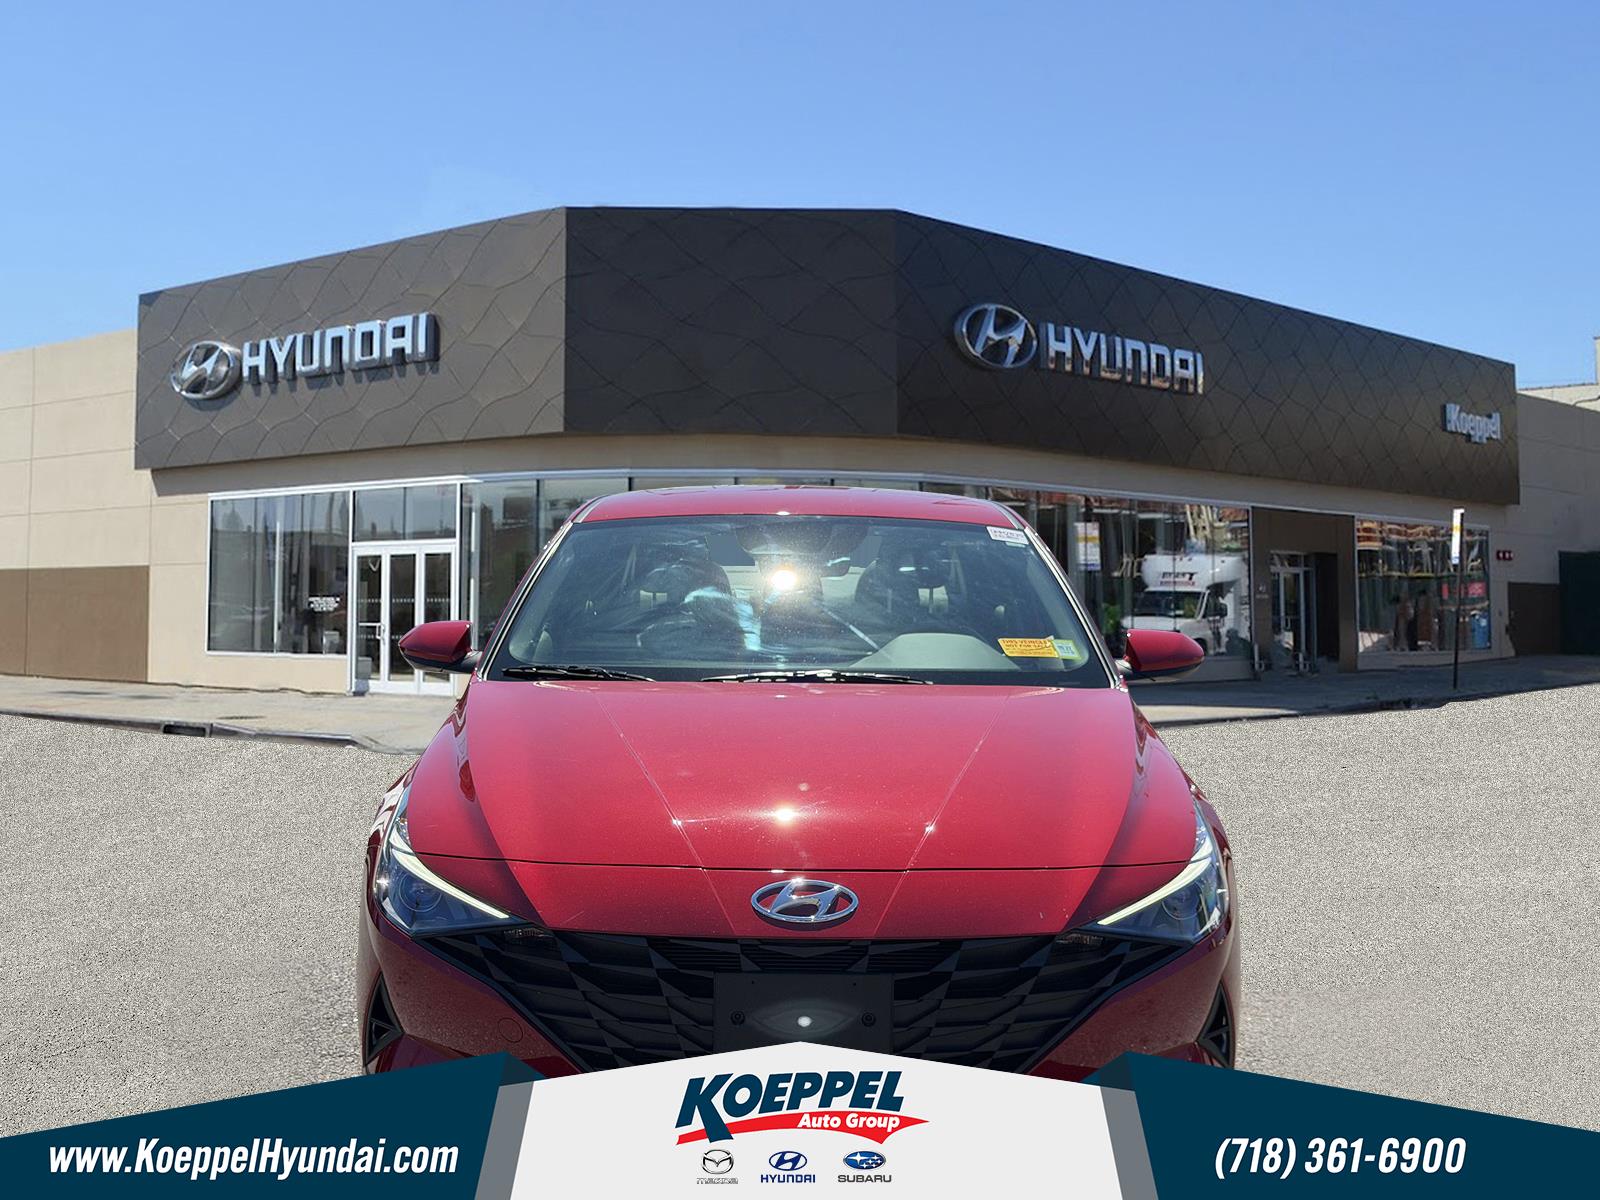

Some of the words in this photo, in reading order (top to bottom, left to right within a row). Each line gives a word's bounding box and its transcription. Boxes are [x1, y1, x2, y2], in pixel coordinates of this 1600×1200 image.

[242, 311, 432, 385] HYUNDAI
[1045, 322, 1204, 395] HYUNDAI
[1445, 403, 1501, 444] Koeppel
